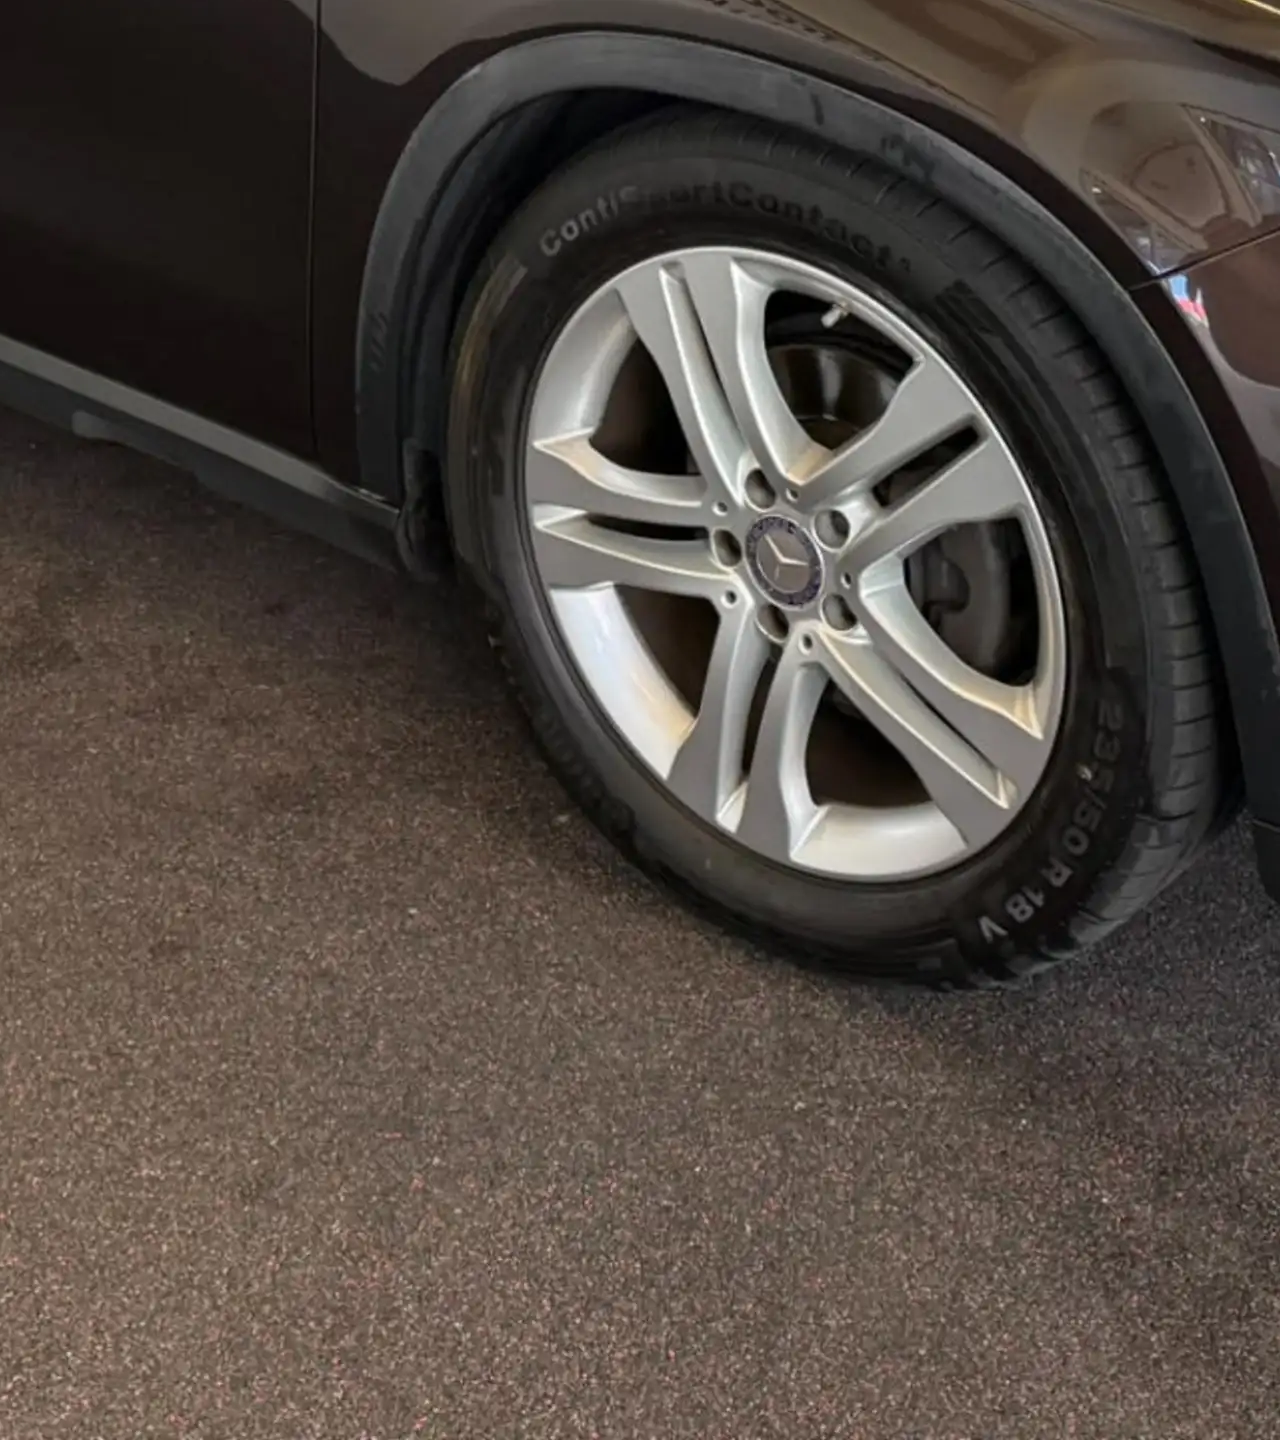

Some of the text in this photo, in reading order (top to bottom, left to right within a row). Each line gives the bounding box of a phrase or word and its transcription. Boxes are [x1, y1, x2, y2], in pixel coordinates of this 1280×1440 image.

[1040, 856, 1074, 888] R
[1004, 885, 1045, 924] 18
[977, 915, 1010, 944] V
